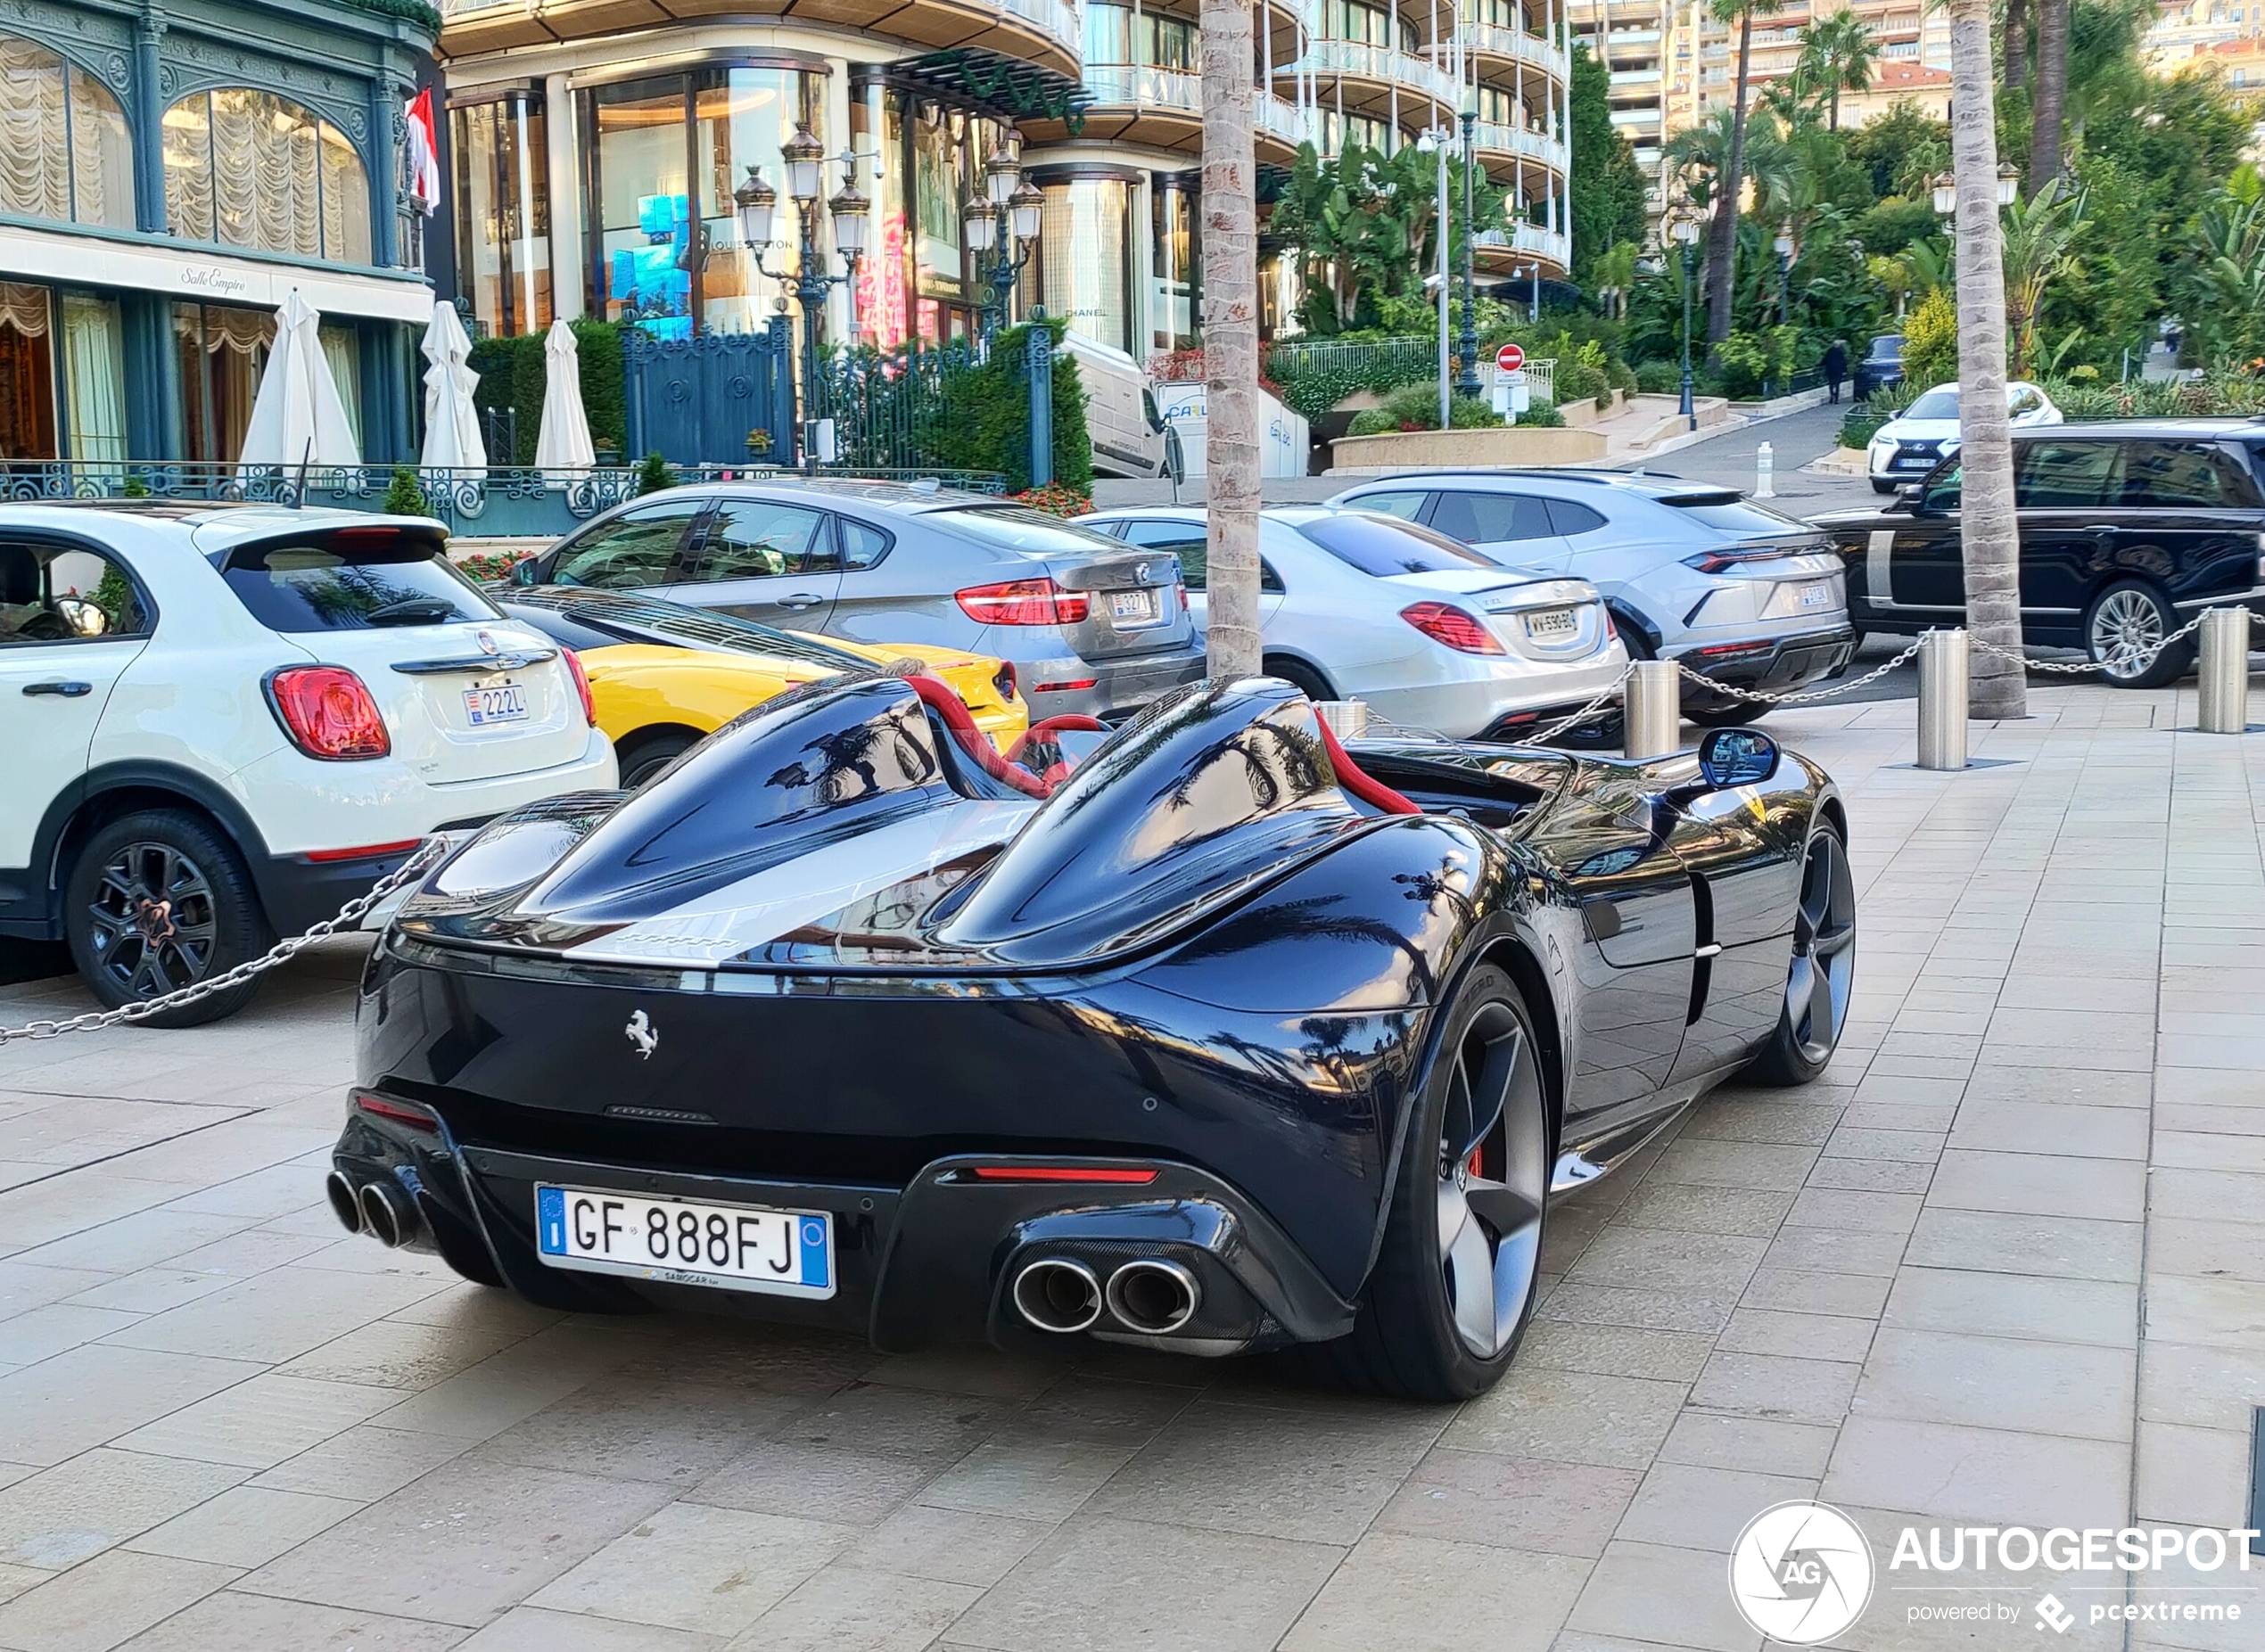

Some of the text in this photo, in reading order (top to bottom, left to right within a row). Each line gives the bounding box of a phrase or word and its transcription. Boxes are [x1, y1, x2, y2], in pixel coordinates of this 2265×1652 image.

[181, 267, 245, 295] Salle Empire
[1065, 308, 1108, 317] CHANEL
[483, 689, 523, 716] 222L
[574, 1198, 624, 1253] GF
[646, 1206, 792, 1273] 888FJ
